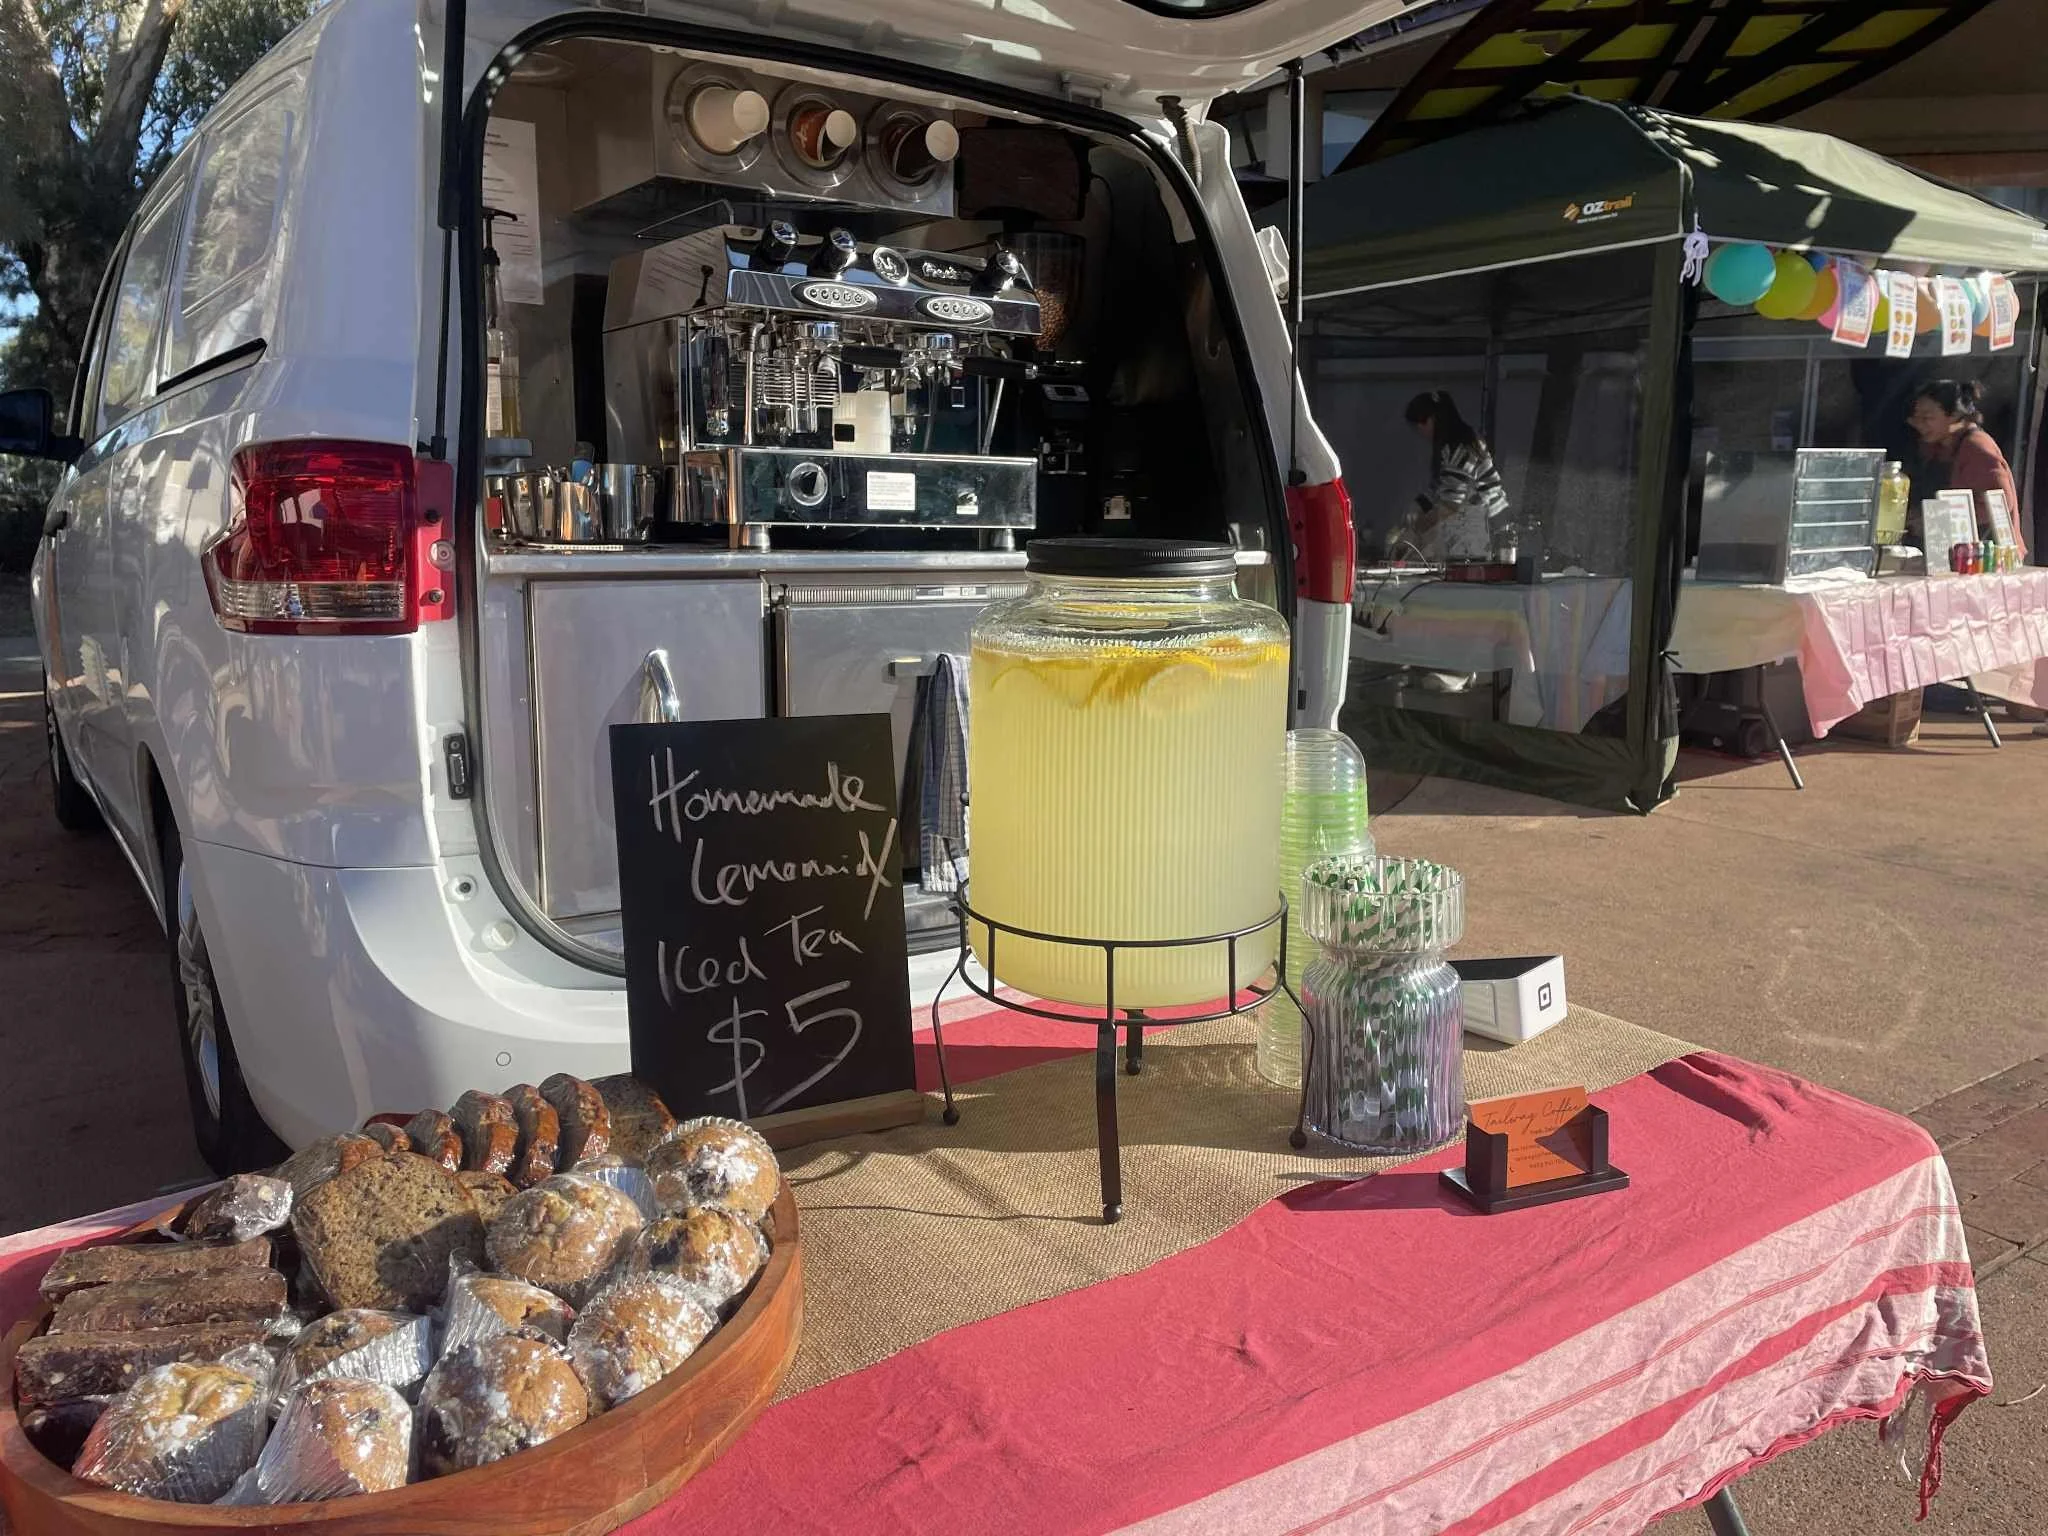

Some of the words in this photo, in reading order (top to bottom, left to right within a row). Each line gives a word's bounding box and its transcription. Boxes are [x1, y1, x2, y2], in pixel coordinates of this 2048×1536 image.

[649, 746, 887, 843] Homemade
[657, 936, 767, 1007] Iced
[763, 905, 864, 966] Tea
